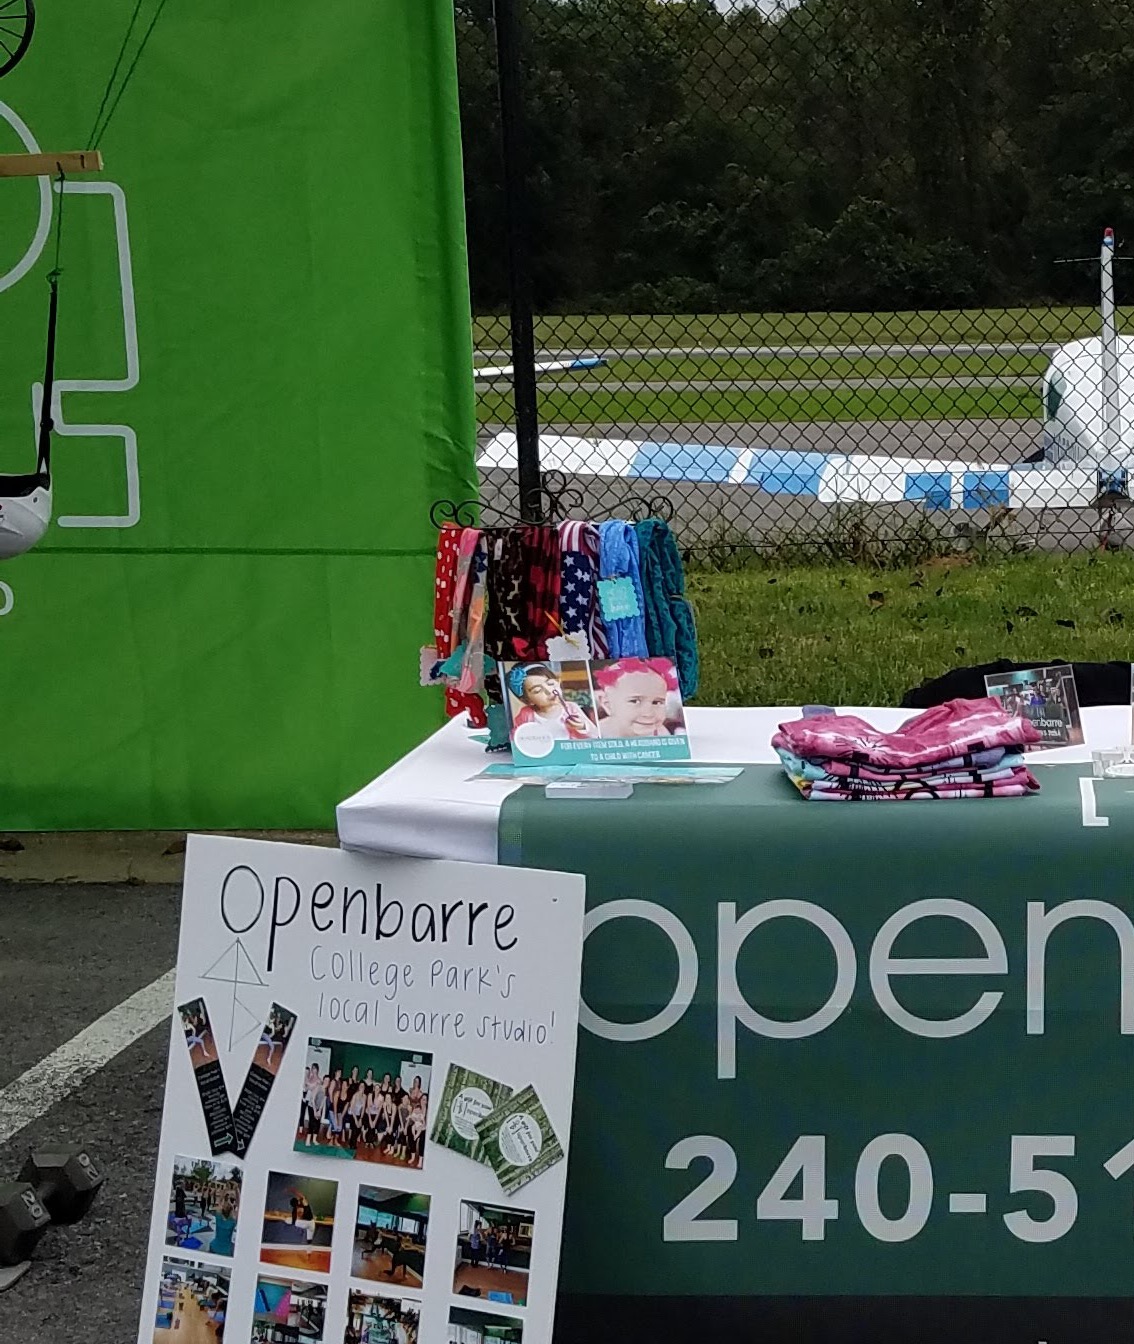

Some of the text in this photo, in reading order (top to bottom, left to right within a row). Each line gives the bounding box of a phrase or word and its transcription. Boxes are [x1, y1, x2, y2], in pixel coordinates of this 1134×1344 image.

[220, 865, 519, 972] Openbarre
[311, 944, 517, 1001] College Park's
[318, 992, 556, 1045] local barre studio!
